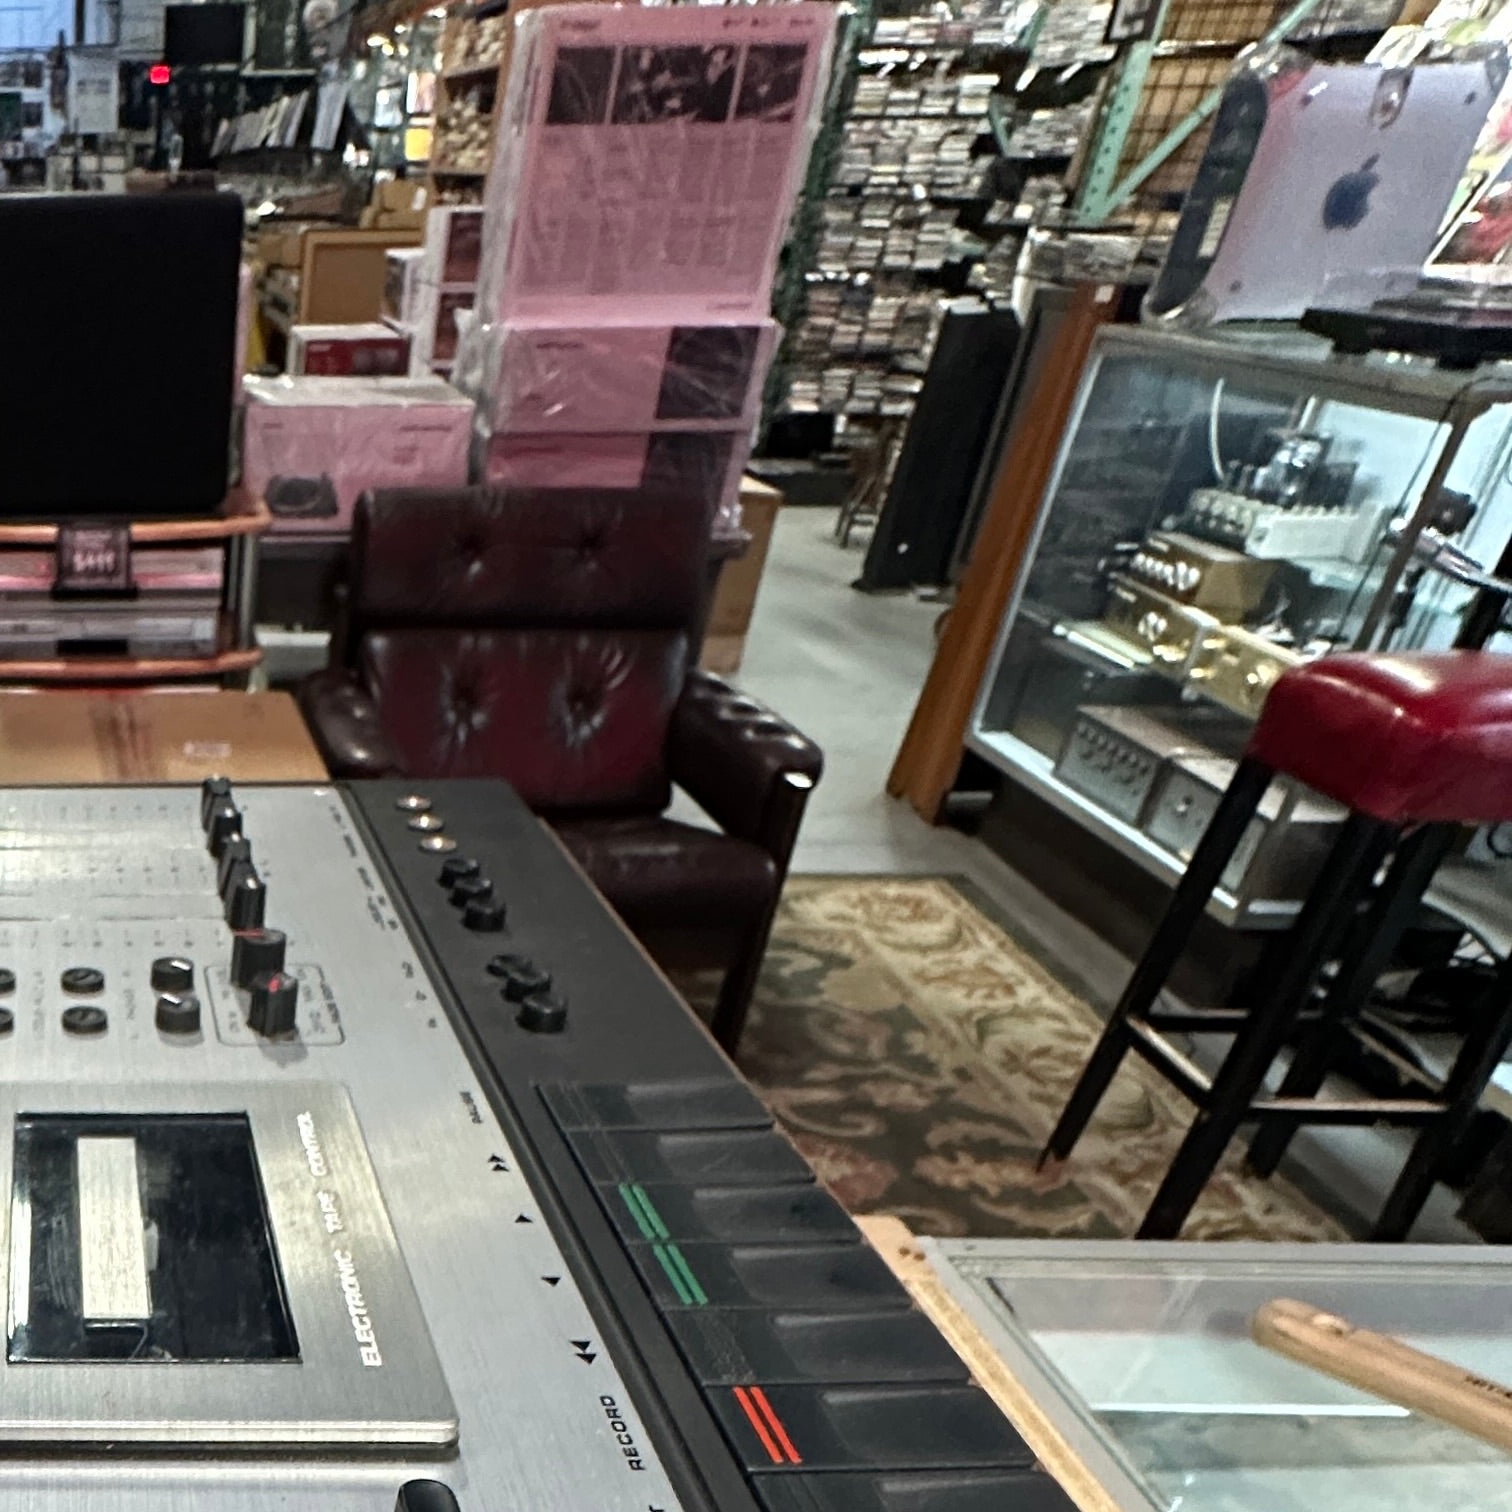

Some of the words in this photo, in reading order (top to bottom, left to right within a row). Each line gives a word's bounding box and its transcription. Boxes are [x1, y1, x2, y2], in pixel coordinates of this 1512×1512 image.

[296, 1110, 330, 1177] CONTROL
[317, 1190, 344, 1234] TAPE
[334, 1250, 383, 1367] ELECTRONIC
[599, 1394, 647, 1472] RECORD
